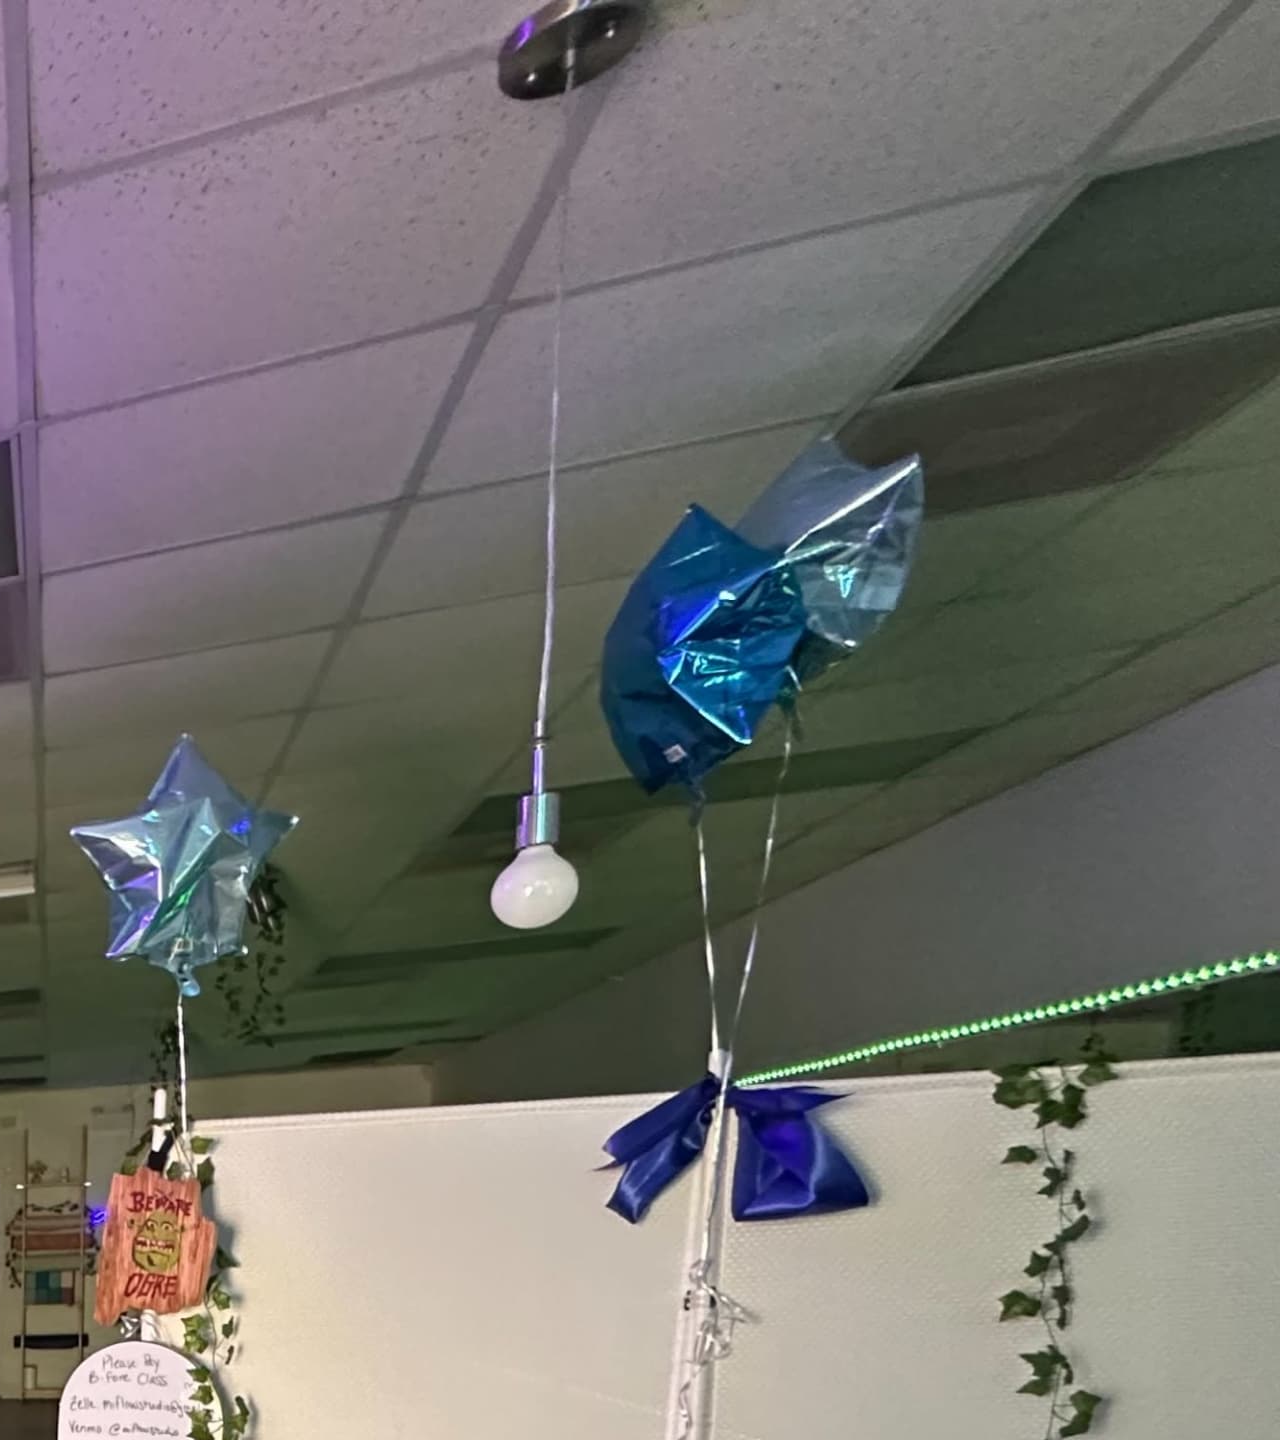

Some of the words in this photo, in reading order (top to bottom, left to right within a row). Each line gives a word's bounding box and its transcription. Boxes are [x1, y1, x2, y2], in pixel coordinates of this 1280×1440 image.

[126, 1190, 193, 1217] BEWARE
[123, 1272, 179, 1299] OGRE
[102, 1354, 137, 1371] Please
[137, 1372, 169, 1387] Class
[68, 1419, 103, 1434] Venmo
